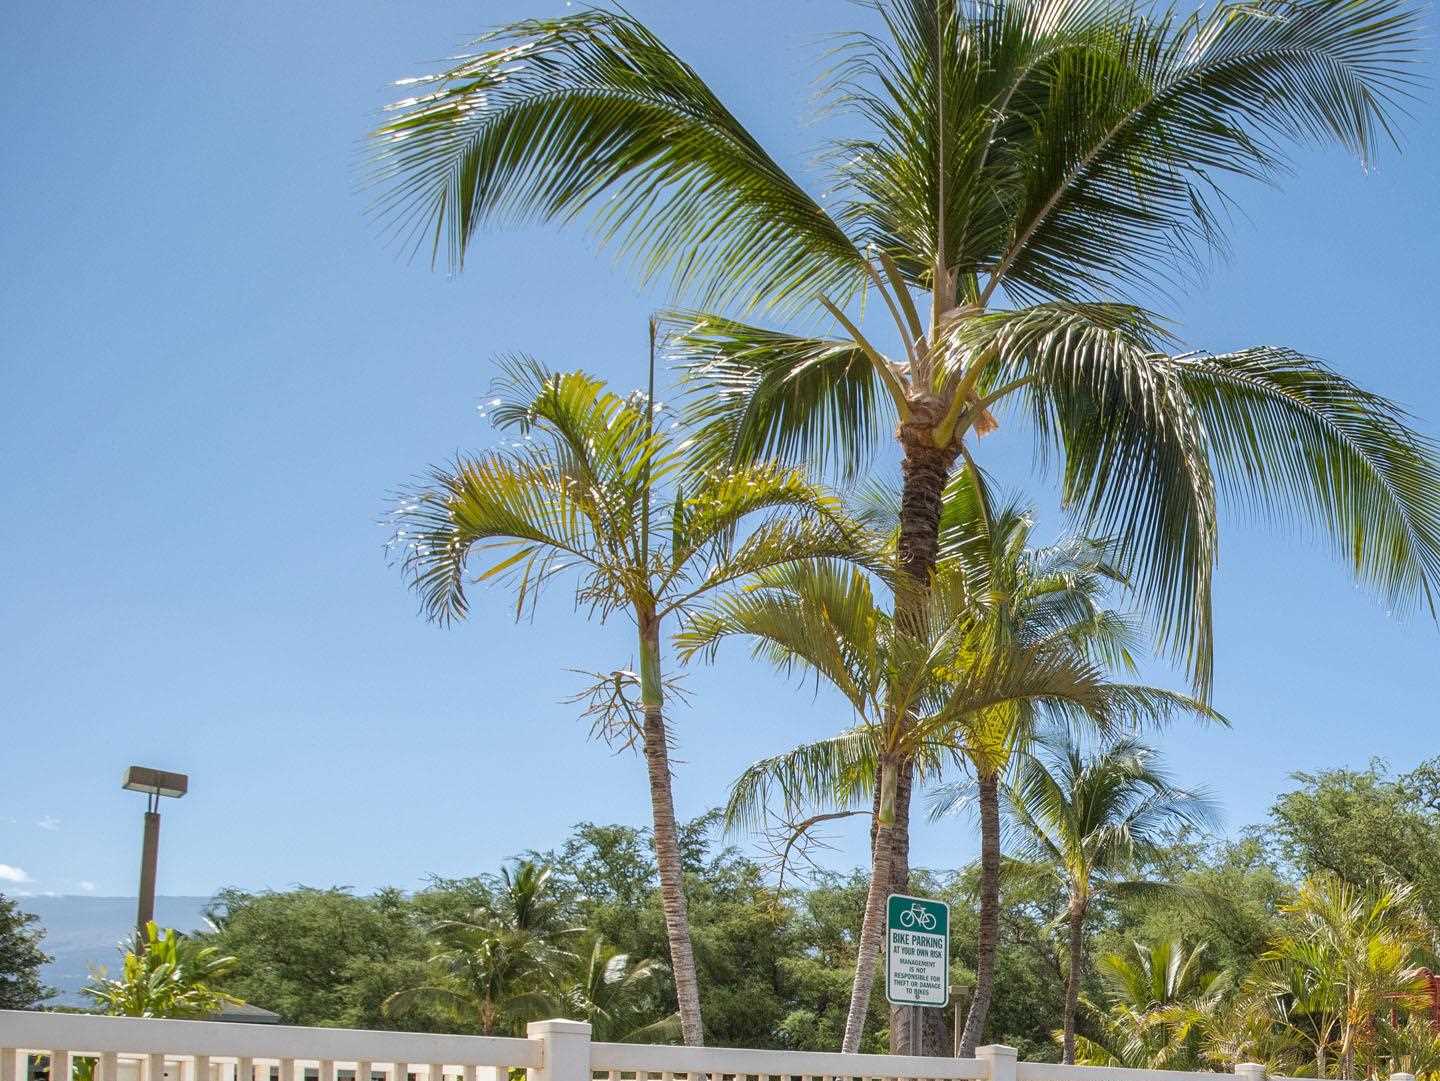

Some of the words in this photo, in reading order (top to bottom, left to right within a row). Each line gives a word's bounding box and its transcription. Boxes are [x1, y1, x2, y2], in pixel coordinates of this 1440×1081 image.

[893, 933, 909, 944] BIKE
[912, 935, 942, 949] PARKING
[902, 947, 915, 955] YOUR
[930, 950, 942, 958] RISK
[900, 959, 936, 967] MANAGEMENT
[894, 972, 929, 981] RESPONSIBLE
[894, 979, 909, 987] THEFT
